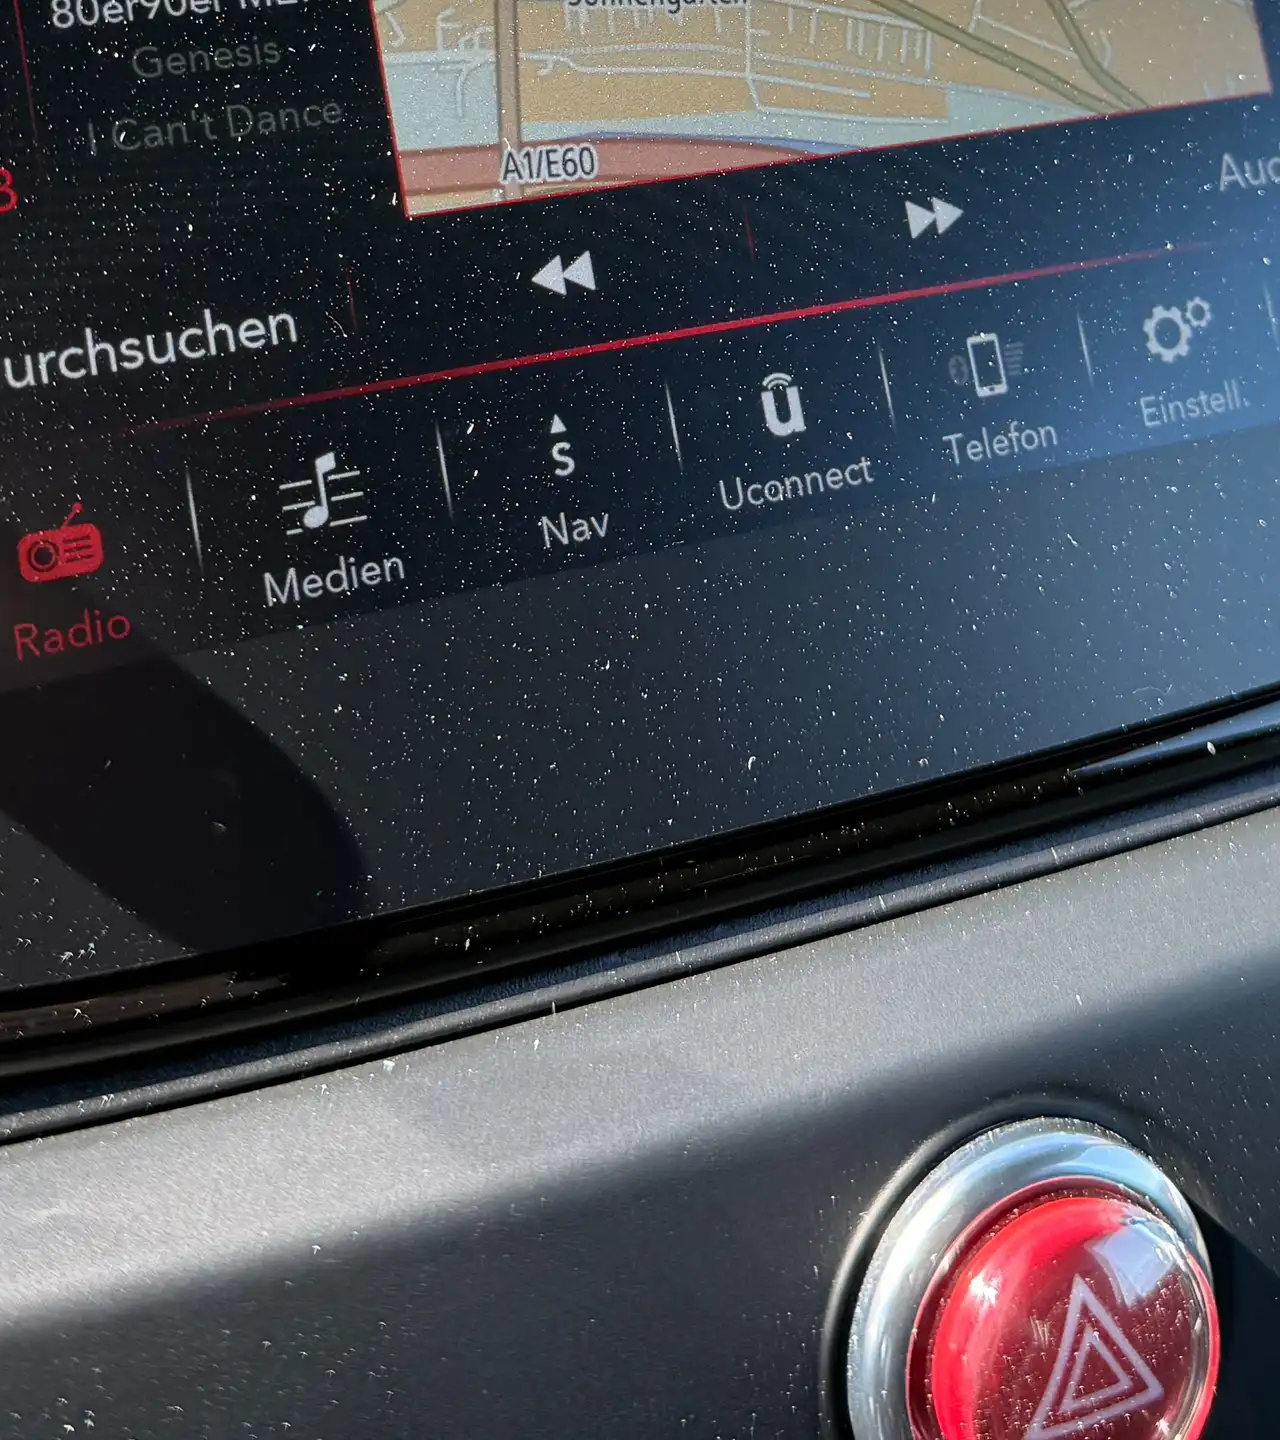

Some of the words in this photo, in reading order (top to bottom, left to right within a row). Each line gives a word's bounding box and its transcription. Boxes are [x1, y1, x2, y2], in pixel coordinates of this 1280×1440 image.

[131, 36, 281, 80] Genesis
[111, 110, 217, 153] Can't
[227, 99, 342, 138] Dance
[501, 144, 595, 182] A1/E60
[1140, 381, 1251, 429] Einstell.
[942, 421, 1058, 465] Telefon
[719, 456, 874, 511] Uconnect
[541, 512, 610, 548] Nav
[264, 554, 405, 607] Medien
[13, 608, 131, 661] Radio
